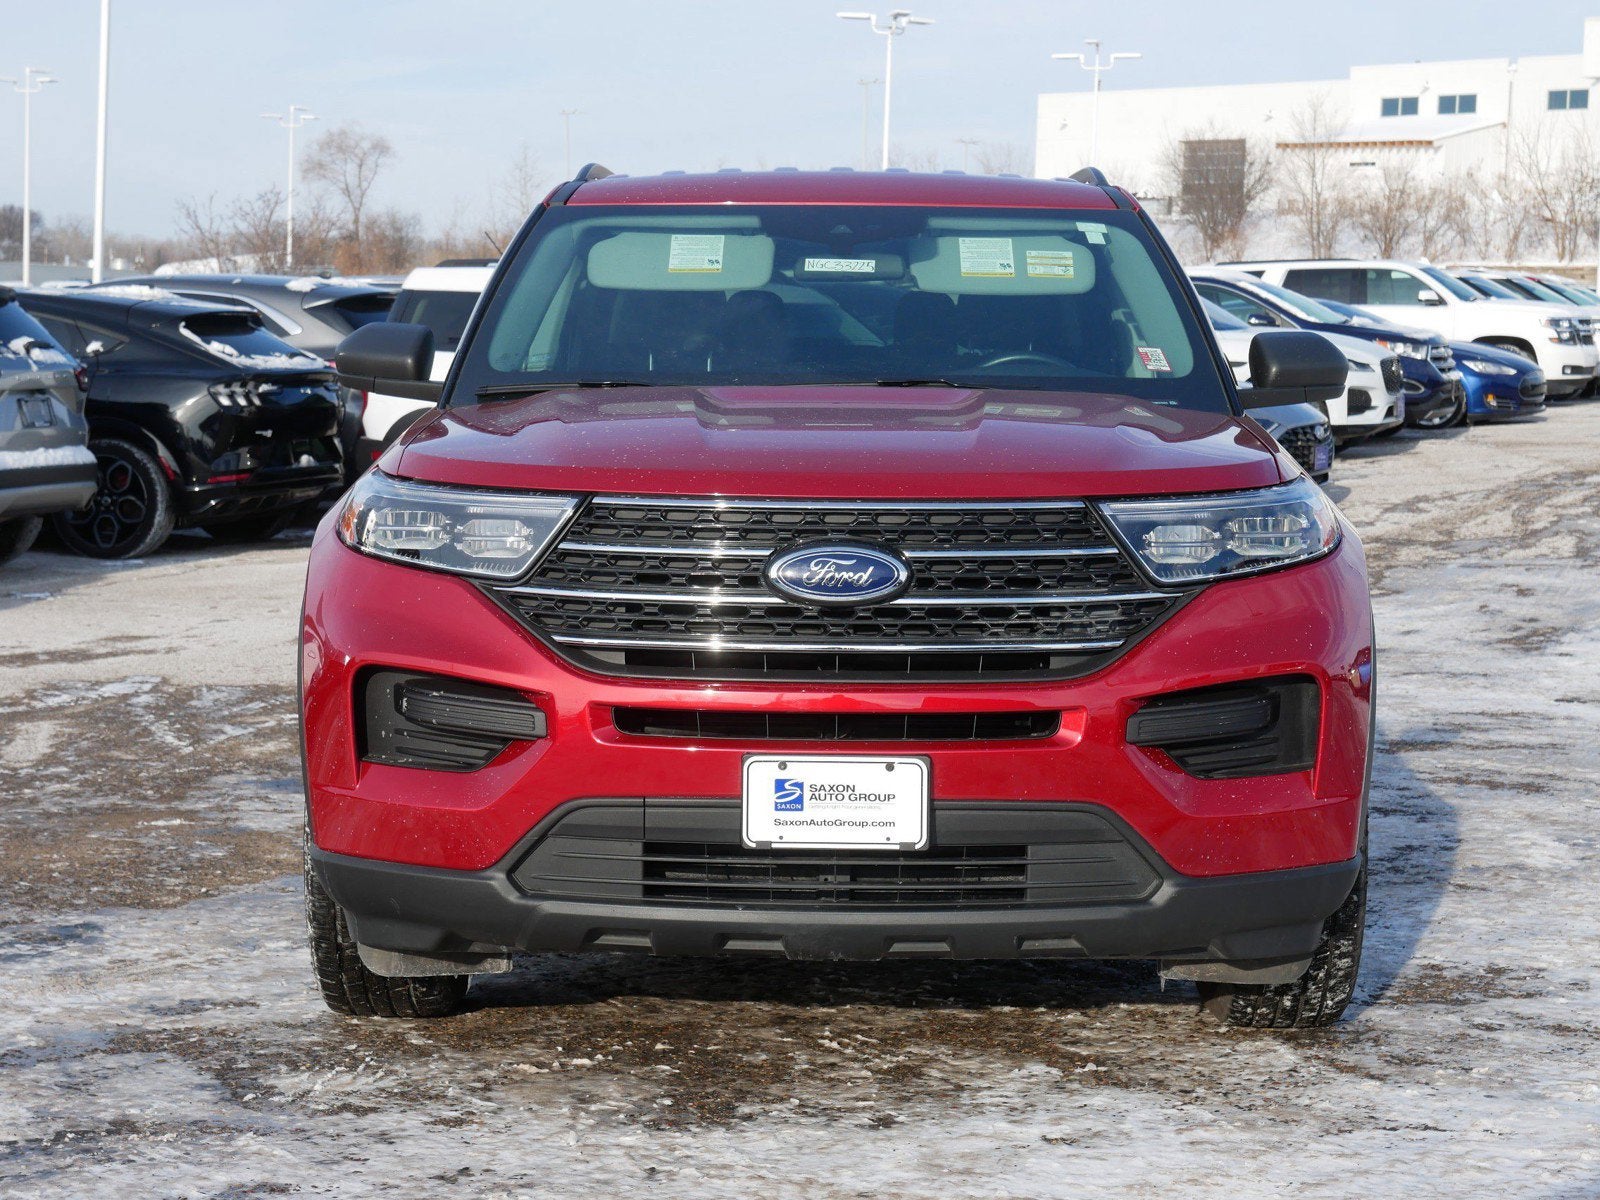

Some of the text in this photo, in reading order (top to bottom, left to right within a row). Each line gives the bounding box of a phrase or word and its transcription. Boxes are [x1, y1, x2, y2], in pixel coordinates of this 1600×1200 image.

[802, 557, 875, 588] Ford
[809, 784, 856, 793] SAXON
[809, 793, 896, 802] AUTO GROUP
[774, 818, 896, 828] SaxonAutoGroup.com
